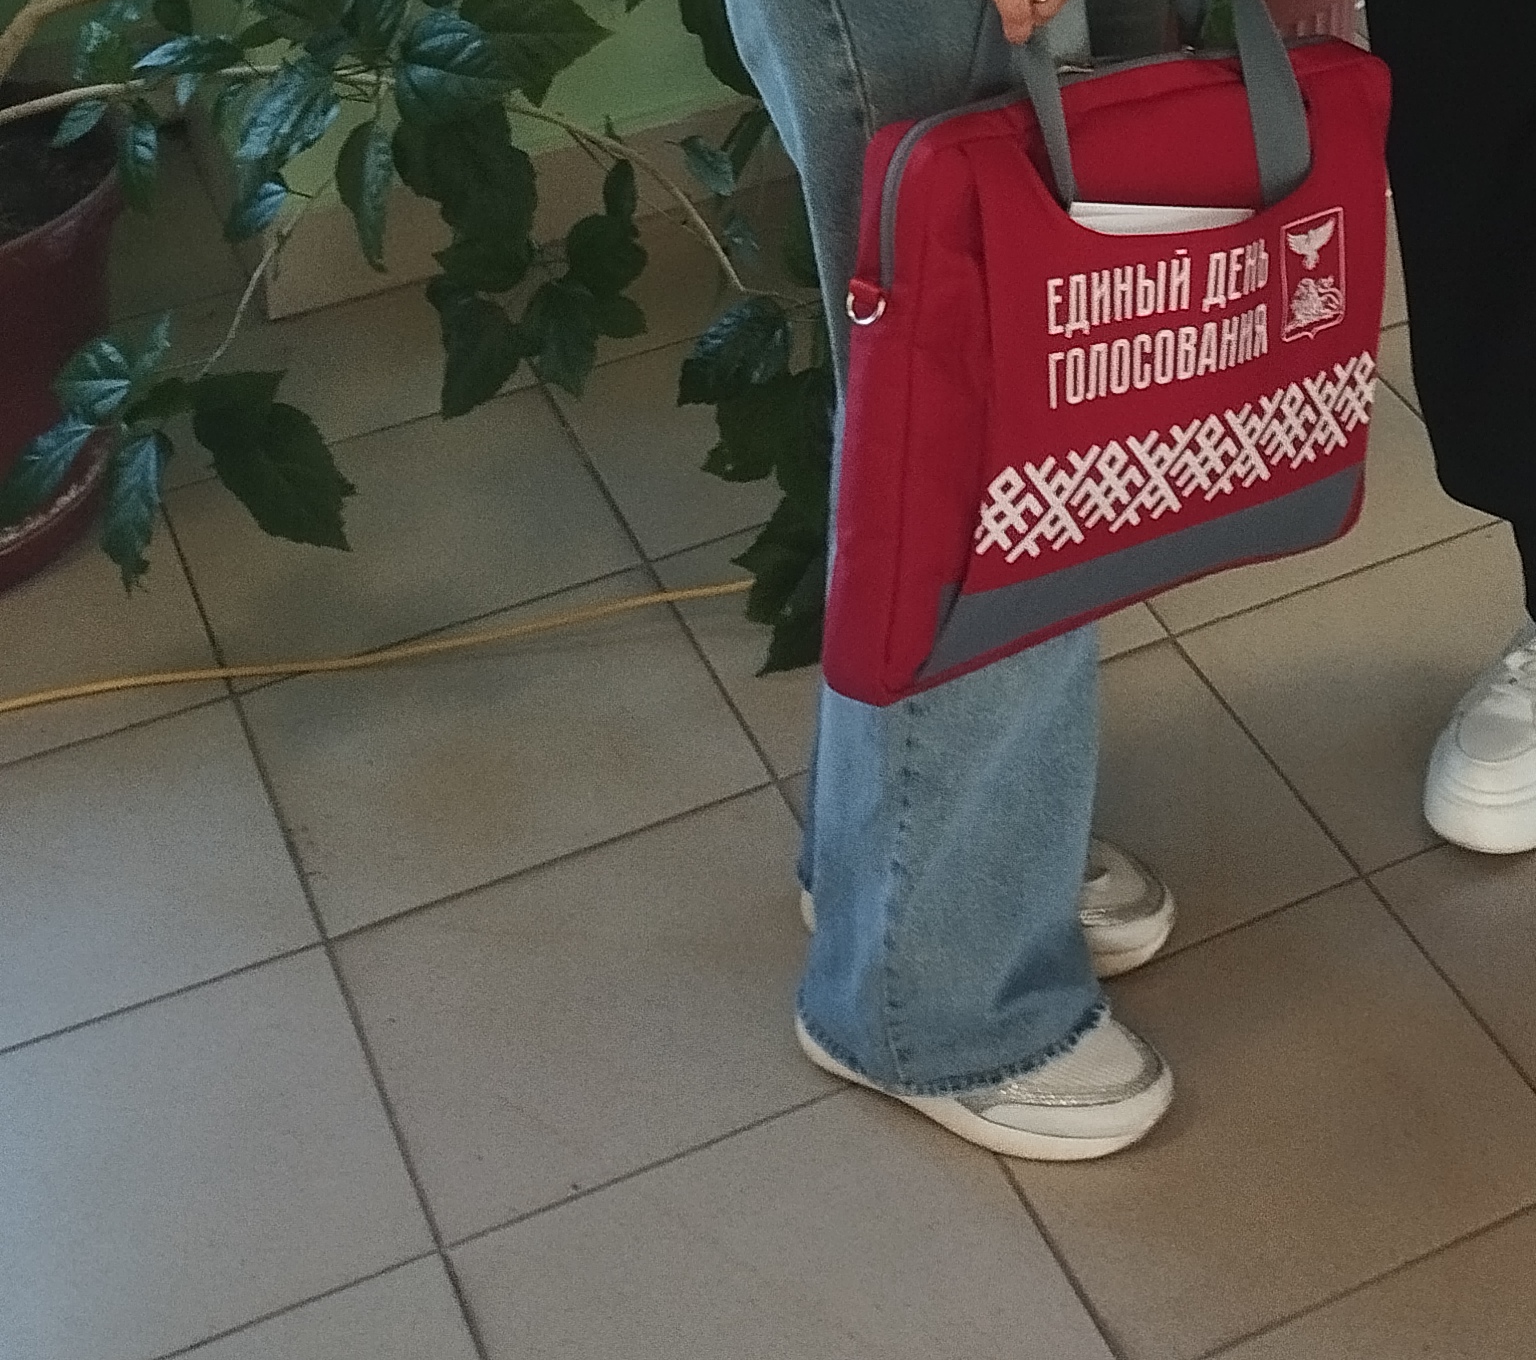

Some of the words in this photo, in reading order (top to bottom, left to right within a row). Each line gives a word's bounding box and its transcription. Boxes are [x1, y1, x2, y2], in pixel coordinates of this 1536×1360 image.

[1047, 248, 1192, 338] ЕДИНЫЙ
[1202, 237, 1269, 313] ДЕНЬ
[1048, 302, 1269, 411] ГОЛОСОВАНИЯ
